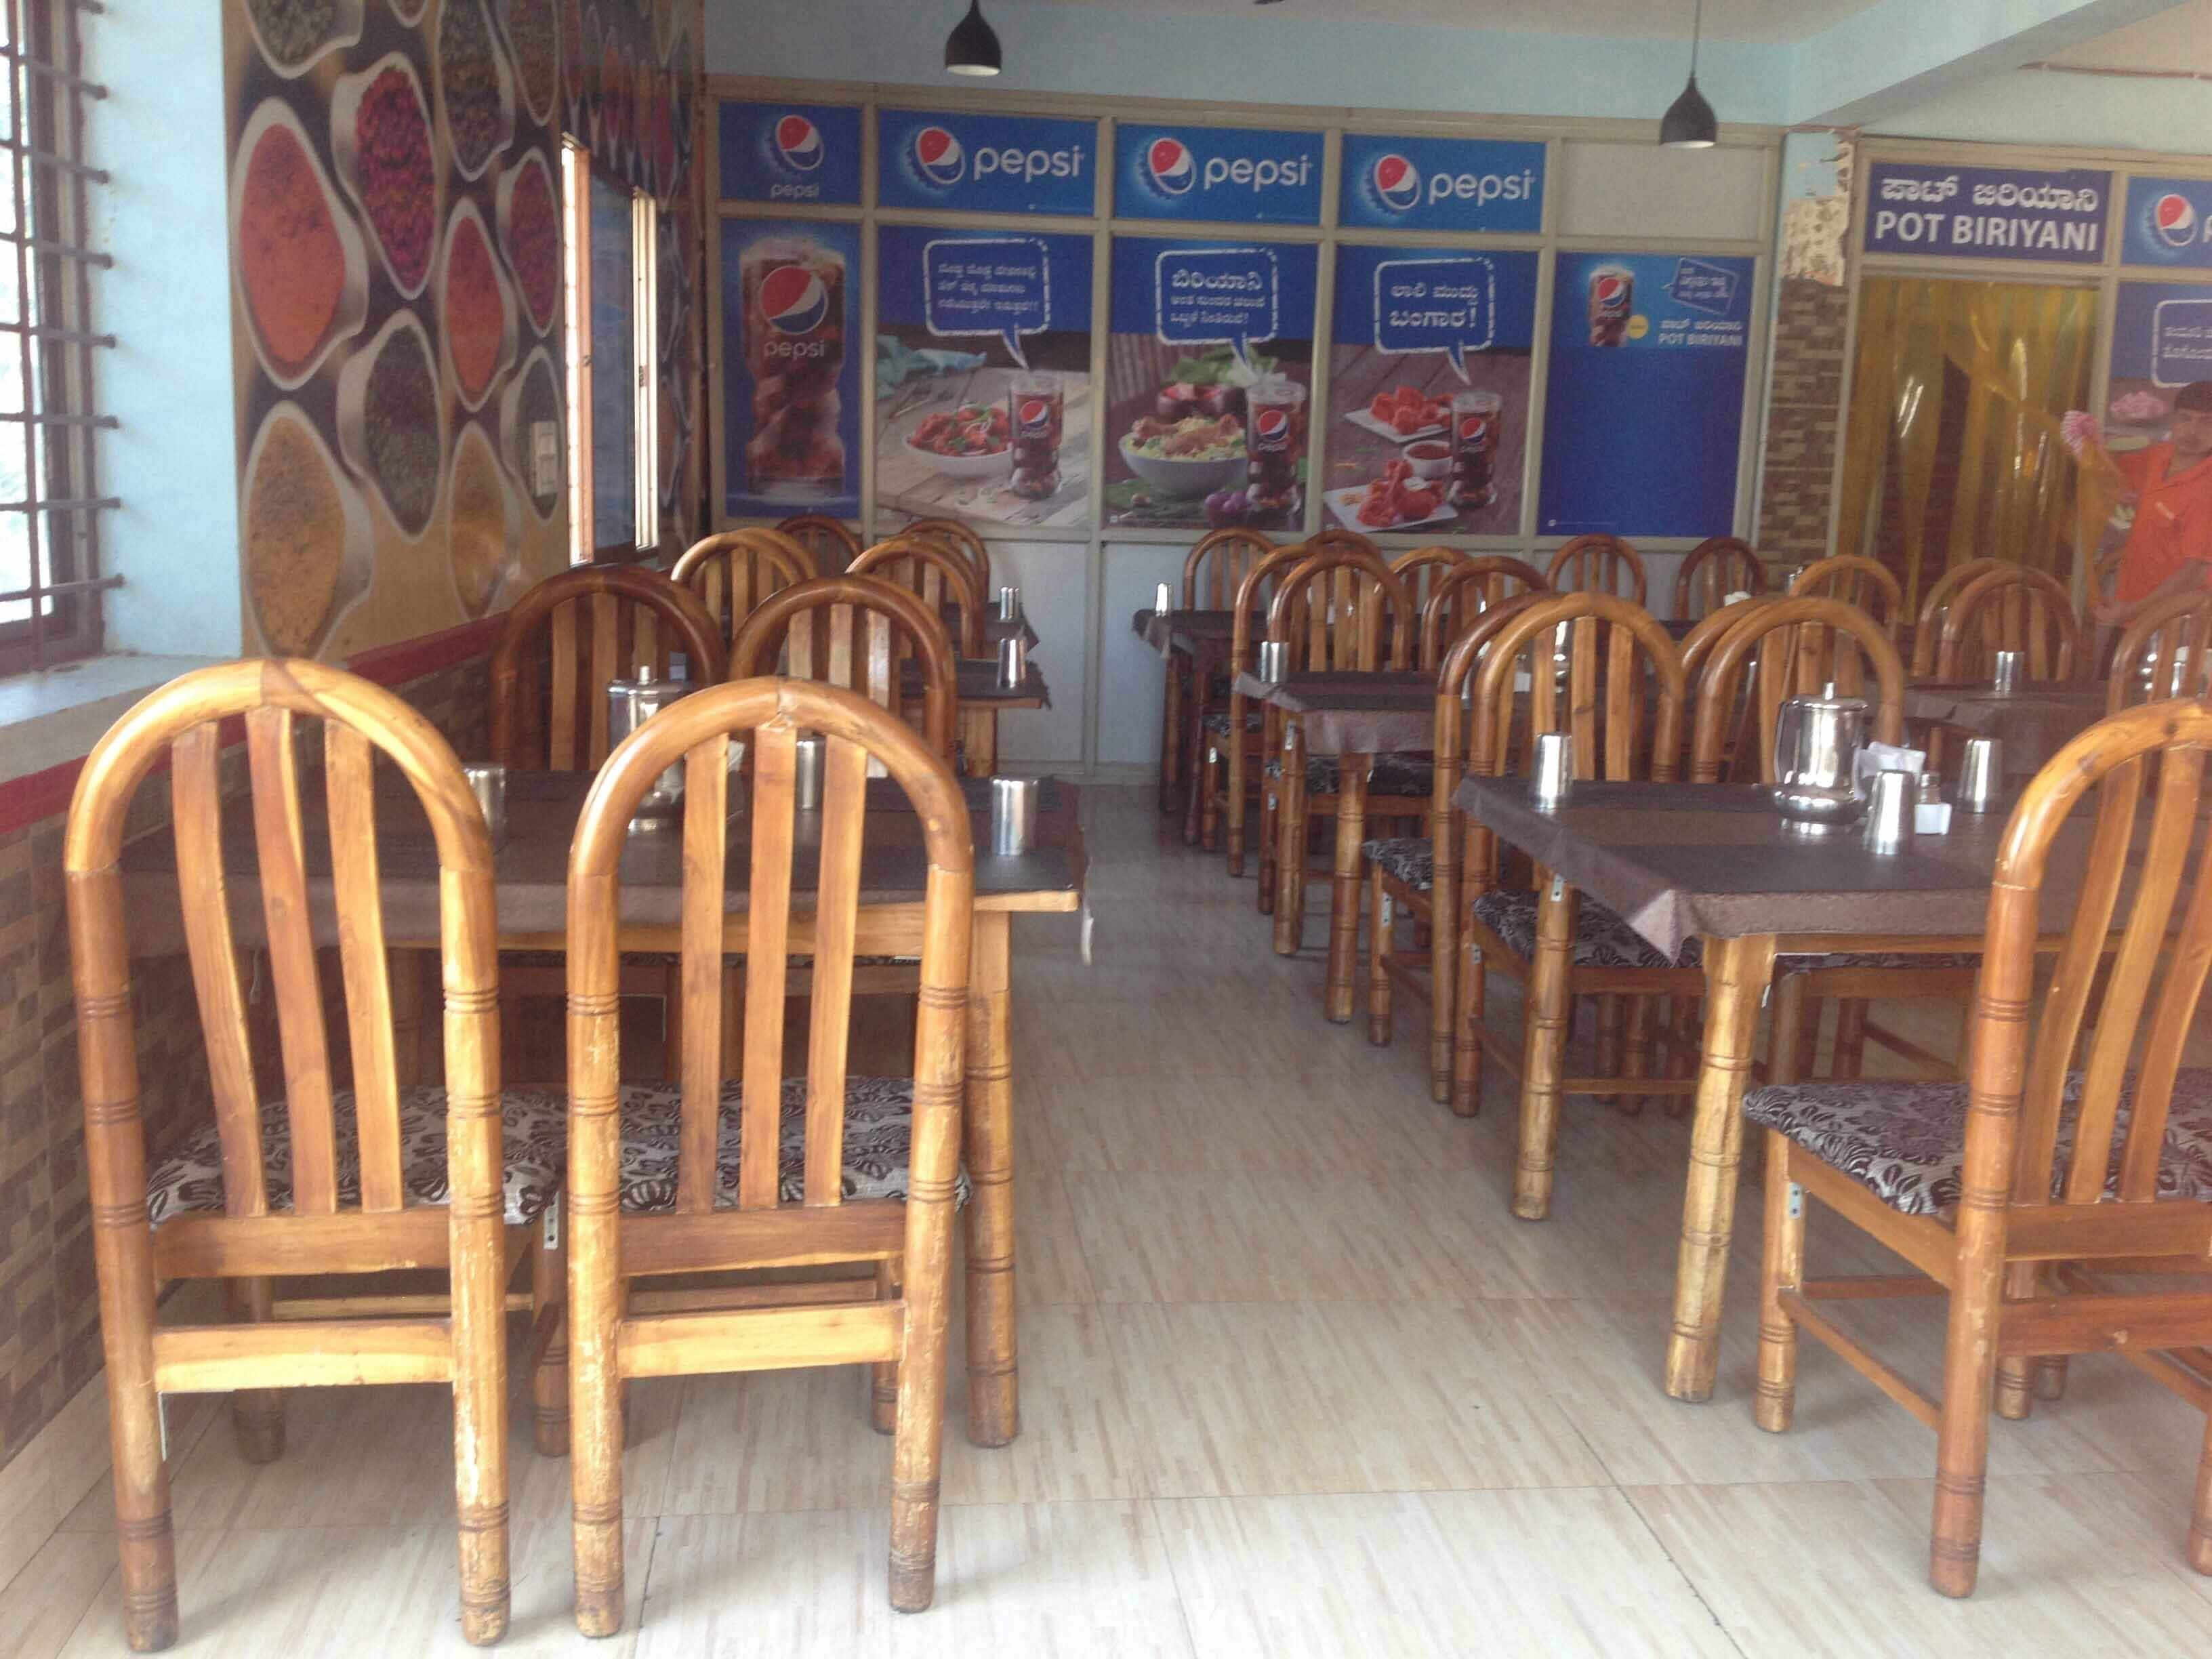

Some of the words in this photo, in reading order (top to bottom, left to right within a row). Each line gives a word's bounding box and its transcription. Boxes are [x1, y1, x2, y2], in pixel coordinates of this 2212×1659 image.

[973, 145, 1082, 182] pepsi
[1204, 155, 1309, 192] pepsi
[771, 182, 819, 198] pepsi
[1429, 169, 1532, 206] pepsi
[1875, 211, 1946, 242] POT
[1951, 214, 2099, 251] BIRIYANI
[764, 339, 824, 362] pepsi
